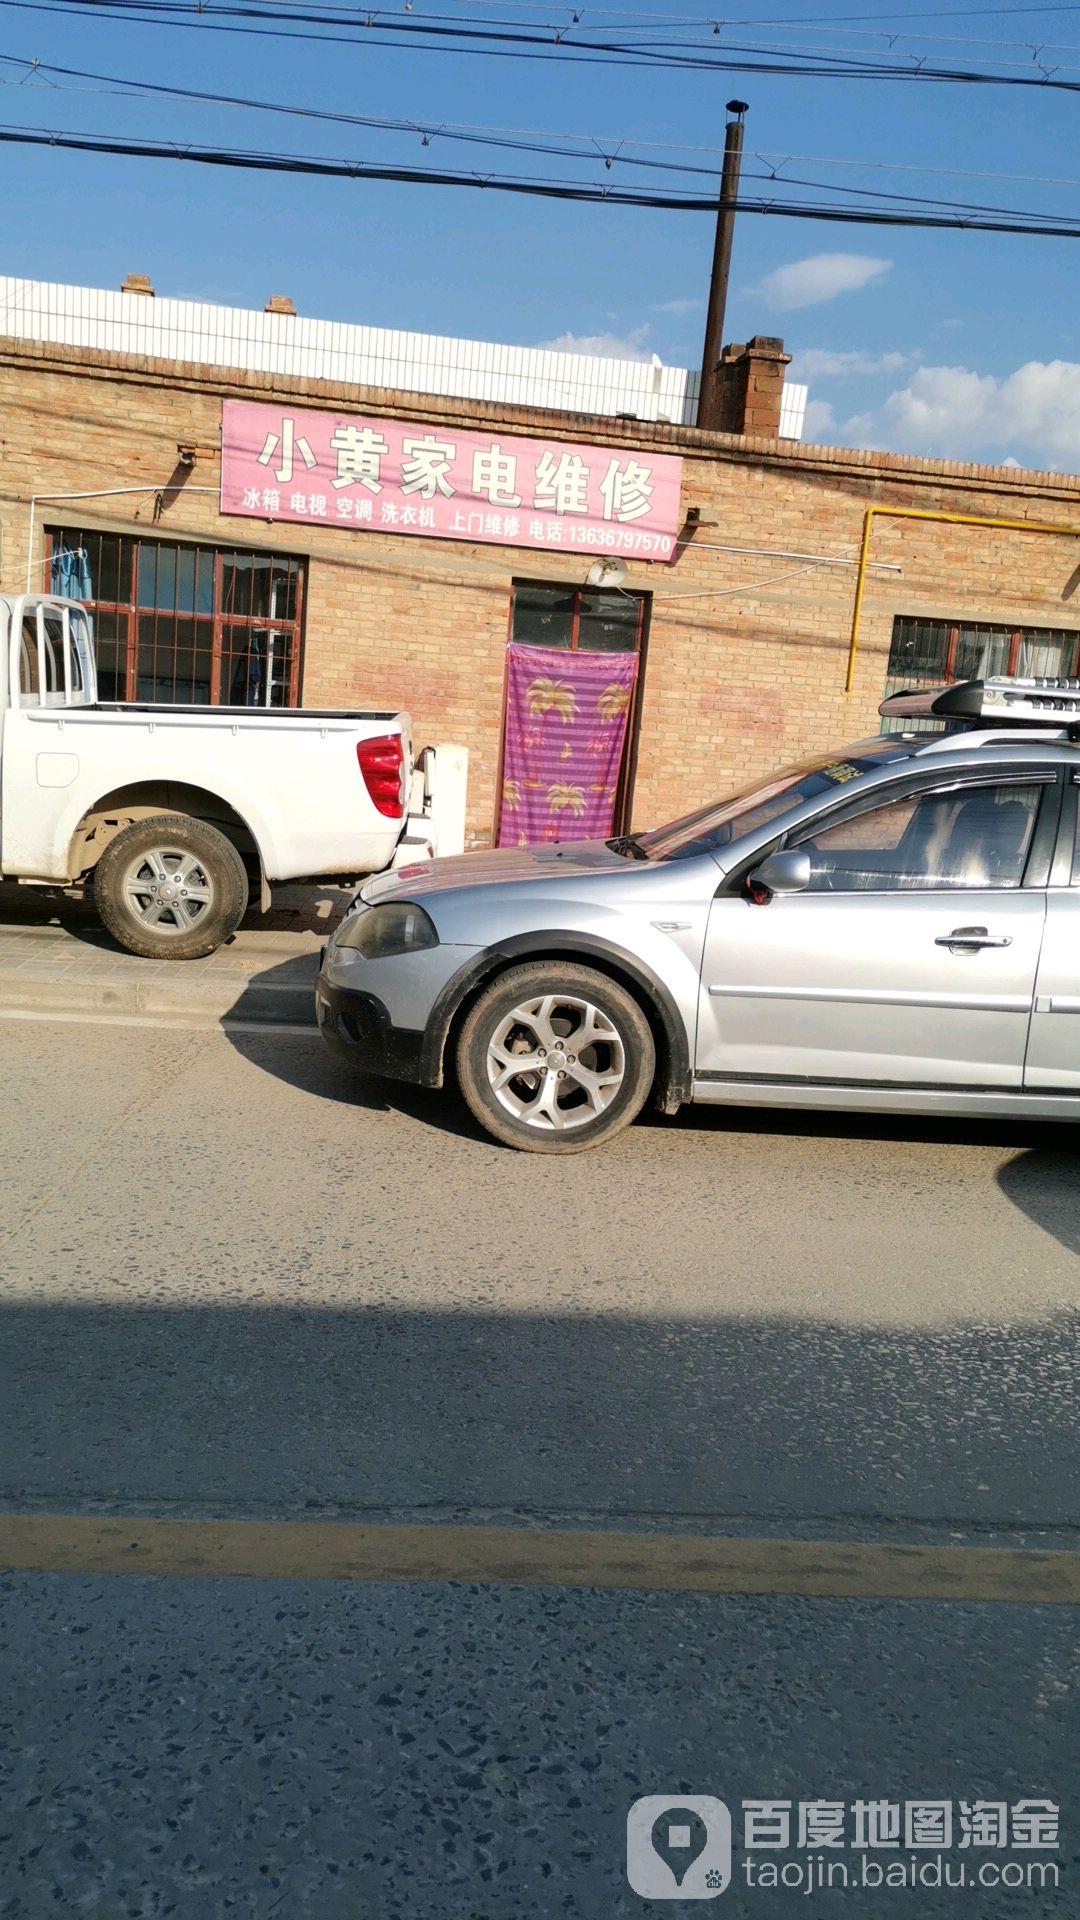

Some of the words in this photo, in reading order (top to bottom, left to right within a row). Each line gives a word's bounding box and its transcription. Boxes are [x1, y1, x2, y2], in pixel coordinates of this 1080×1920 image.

[256, 417, 655, 523] 小黄家电维修
[242, 487, 281, 512] 冰箱
[290, 491, 327, 517] 电视
[336, 497, 373, 522] 空调
[381, 502, 436, 528] 洗衣机
[448, 509, 521, 538] 上门维修
